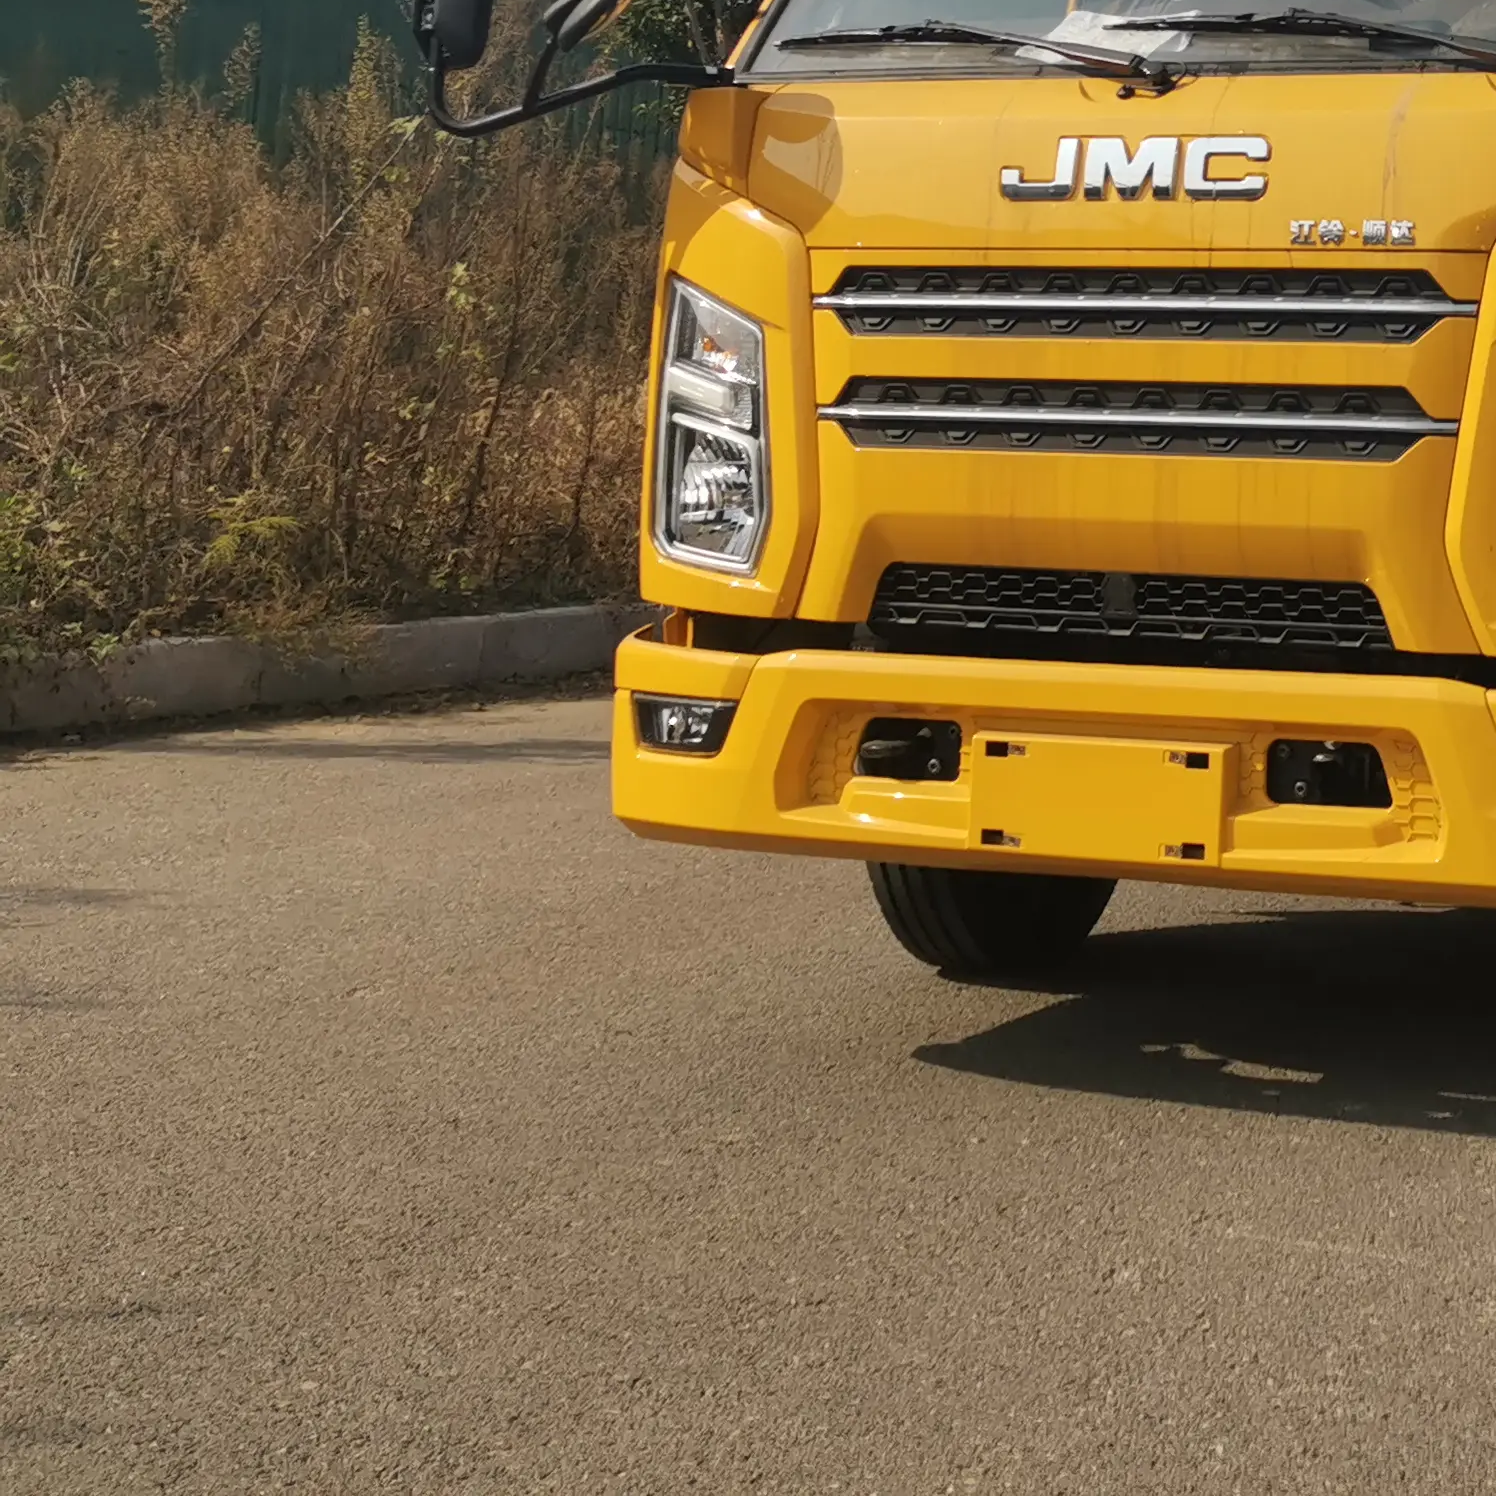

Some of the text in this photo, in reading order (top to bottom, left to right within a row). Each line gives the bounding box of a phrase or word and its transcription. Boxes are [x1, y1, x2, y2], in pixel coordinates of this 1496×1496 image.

[1000, 135, 1271, 200] JMC
[1290, 219, 1416, 245] 江铃·顺达
